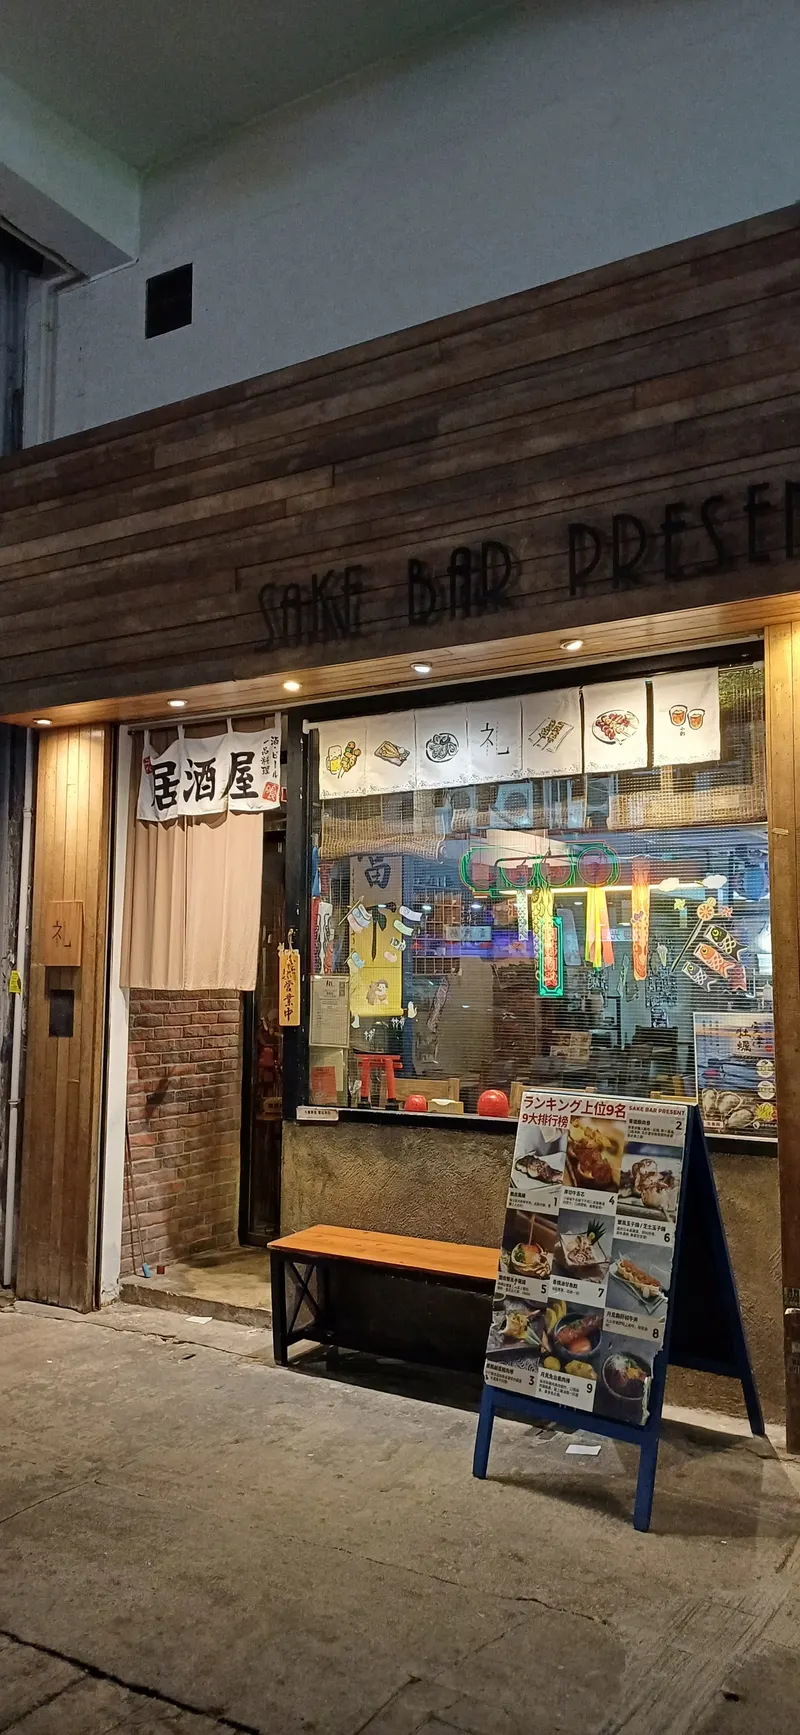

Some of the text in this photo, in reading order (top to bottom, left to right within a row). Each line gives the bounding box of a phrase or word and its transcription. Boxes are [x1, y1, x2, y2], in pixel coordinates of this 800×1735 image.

[255, 564, 364, 652] SAKE
[407, 540, 514, 627] BAR
[151, 752, 259, 811] 居酒屋
[523, 1095, 626, 1119] ランキング上位9名
[628, 1105, 645, 1113] SAKE
[658, 1108, 685, 1116] PRESENT
[522, 1113, 569, 1128] 9大排行榜
[675, 1121, 682, 1131] 2
[553, 1197, 558, 1207] 1
[608, 1196, 616, 1206] 4
[664, 1233, 671, 1242] 6
[541, 1284, 547, 1294] 5
[597, 1288, 605, 1298] 7
[652, 1328, 659, 1339] 8
[528, 1375, 535, 1386] 3
[586, 1383, 593, 1393] 9
